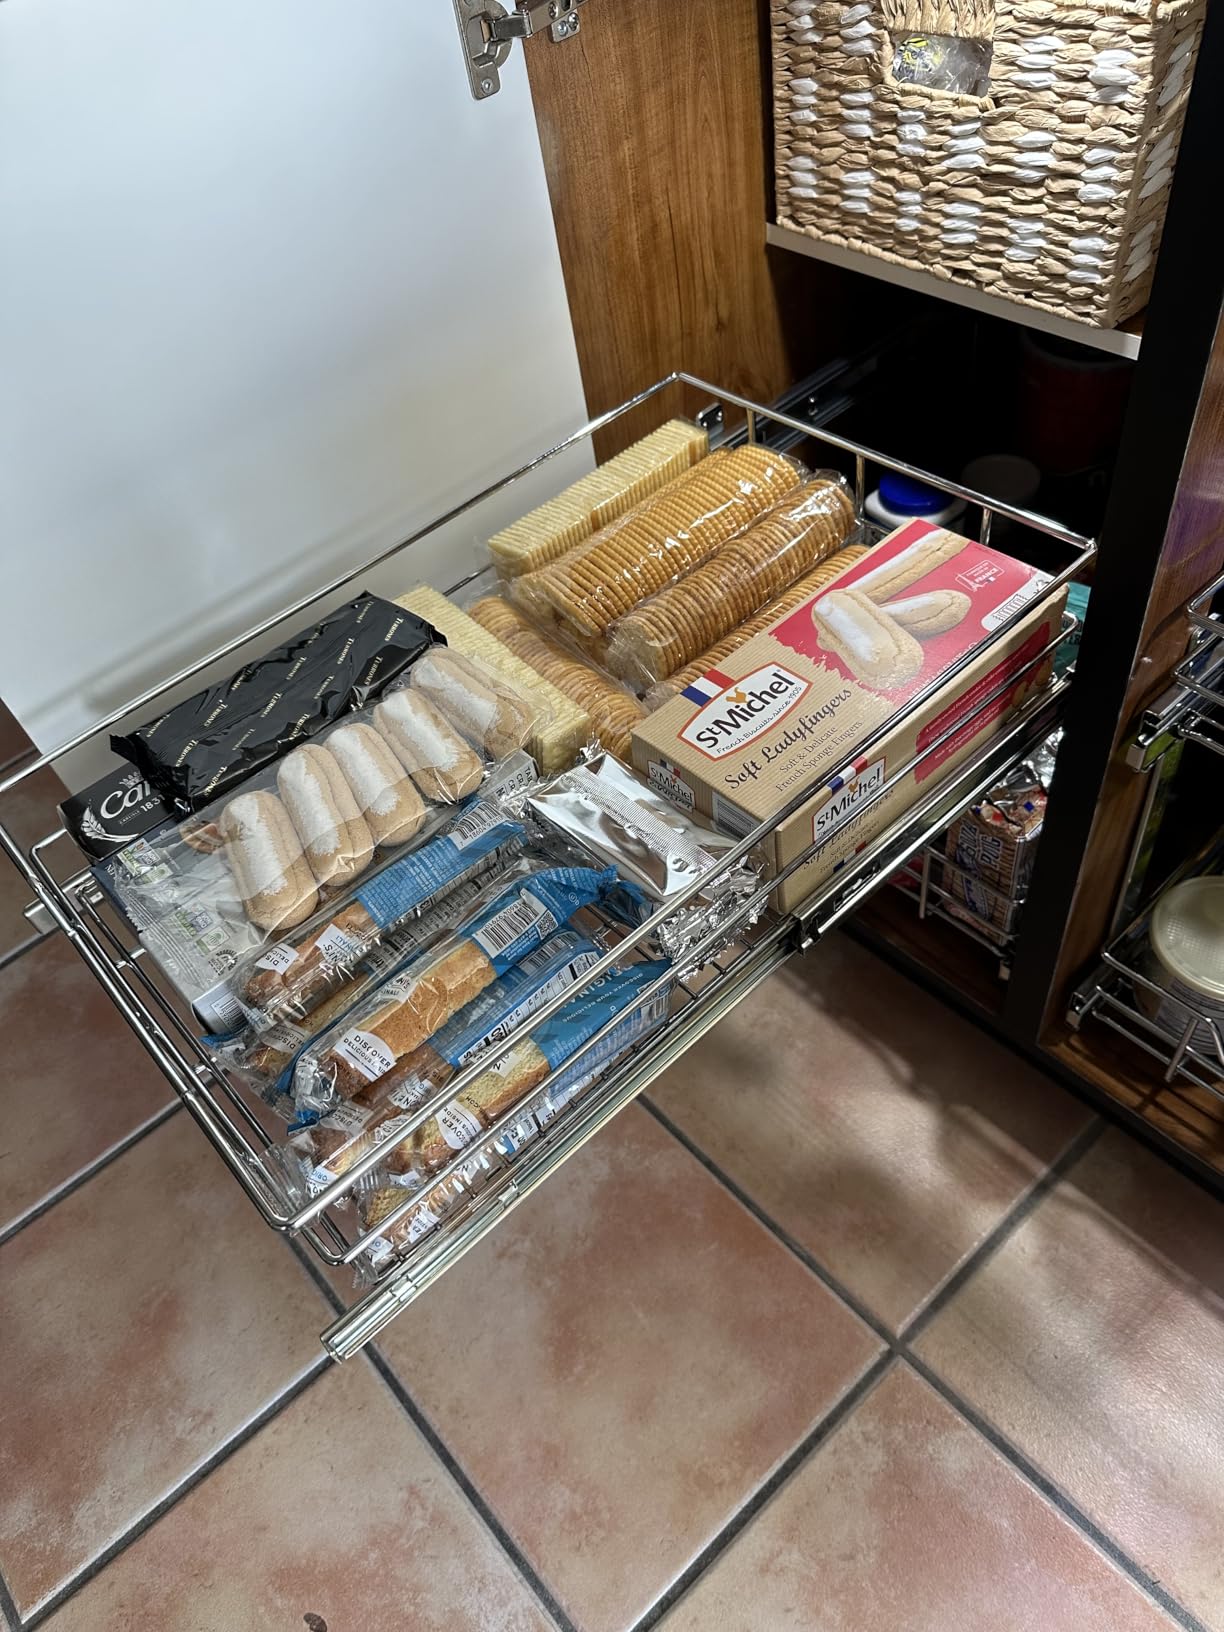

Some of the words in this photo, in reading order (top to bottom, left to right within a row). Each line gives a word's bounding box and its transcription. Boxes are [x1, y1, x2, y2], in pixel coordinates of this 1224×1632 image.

[717, 738, 744, 754] French
[744, 715, 773, 740] Biscuits
[773, 701, 790, 718] since
[789, 687, 802, 701] 1905
[725, 759, 762, 790] Soft
[761, 688, 852, 763] Ladyfingers
[780, 761, 798, 773] Soft
[799, 752, 806, 761] &
[807, 727, 837, 753] Delicate
[776, 767, 804, 792] French
[804, 747, 833, 771] Sponge
[832, 721, 863, 748] Fingers
[523, 767, 534, 781] TAB
[140, 795, 166, 812] 1831
[263, 952, 279, 966] DIS
[270, 948, 289, 963] DELIC
[612, 970, 643, 994] DISCOVER
[561, 998, 596, 1024] DELICIOUS
[342, 1037, 372, 1063] DELICIOUS
